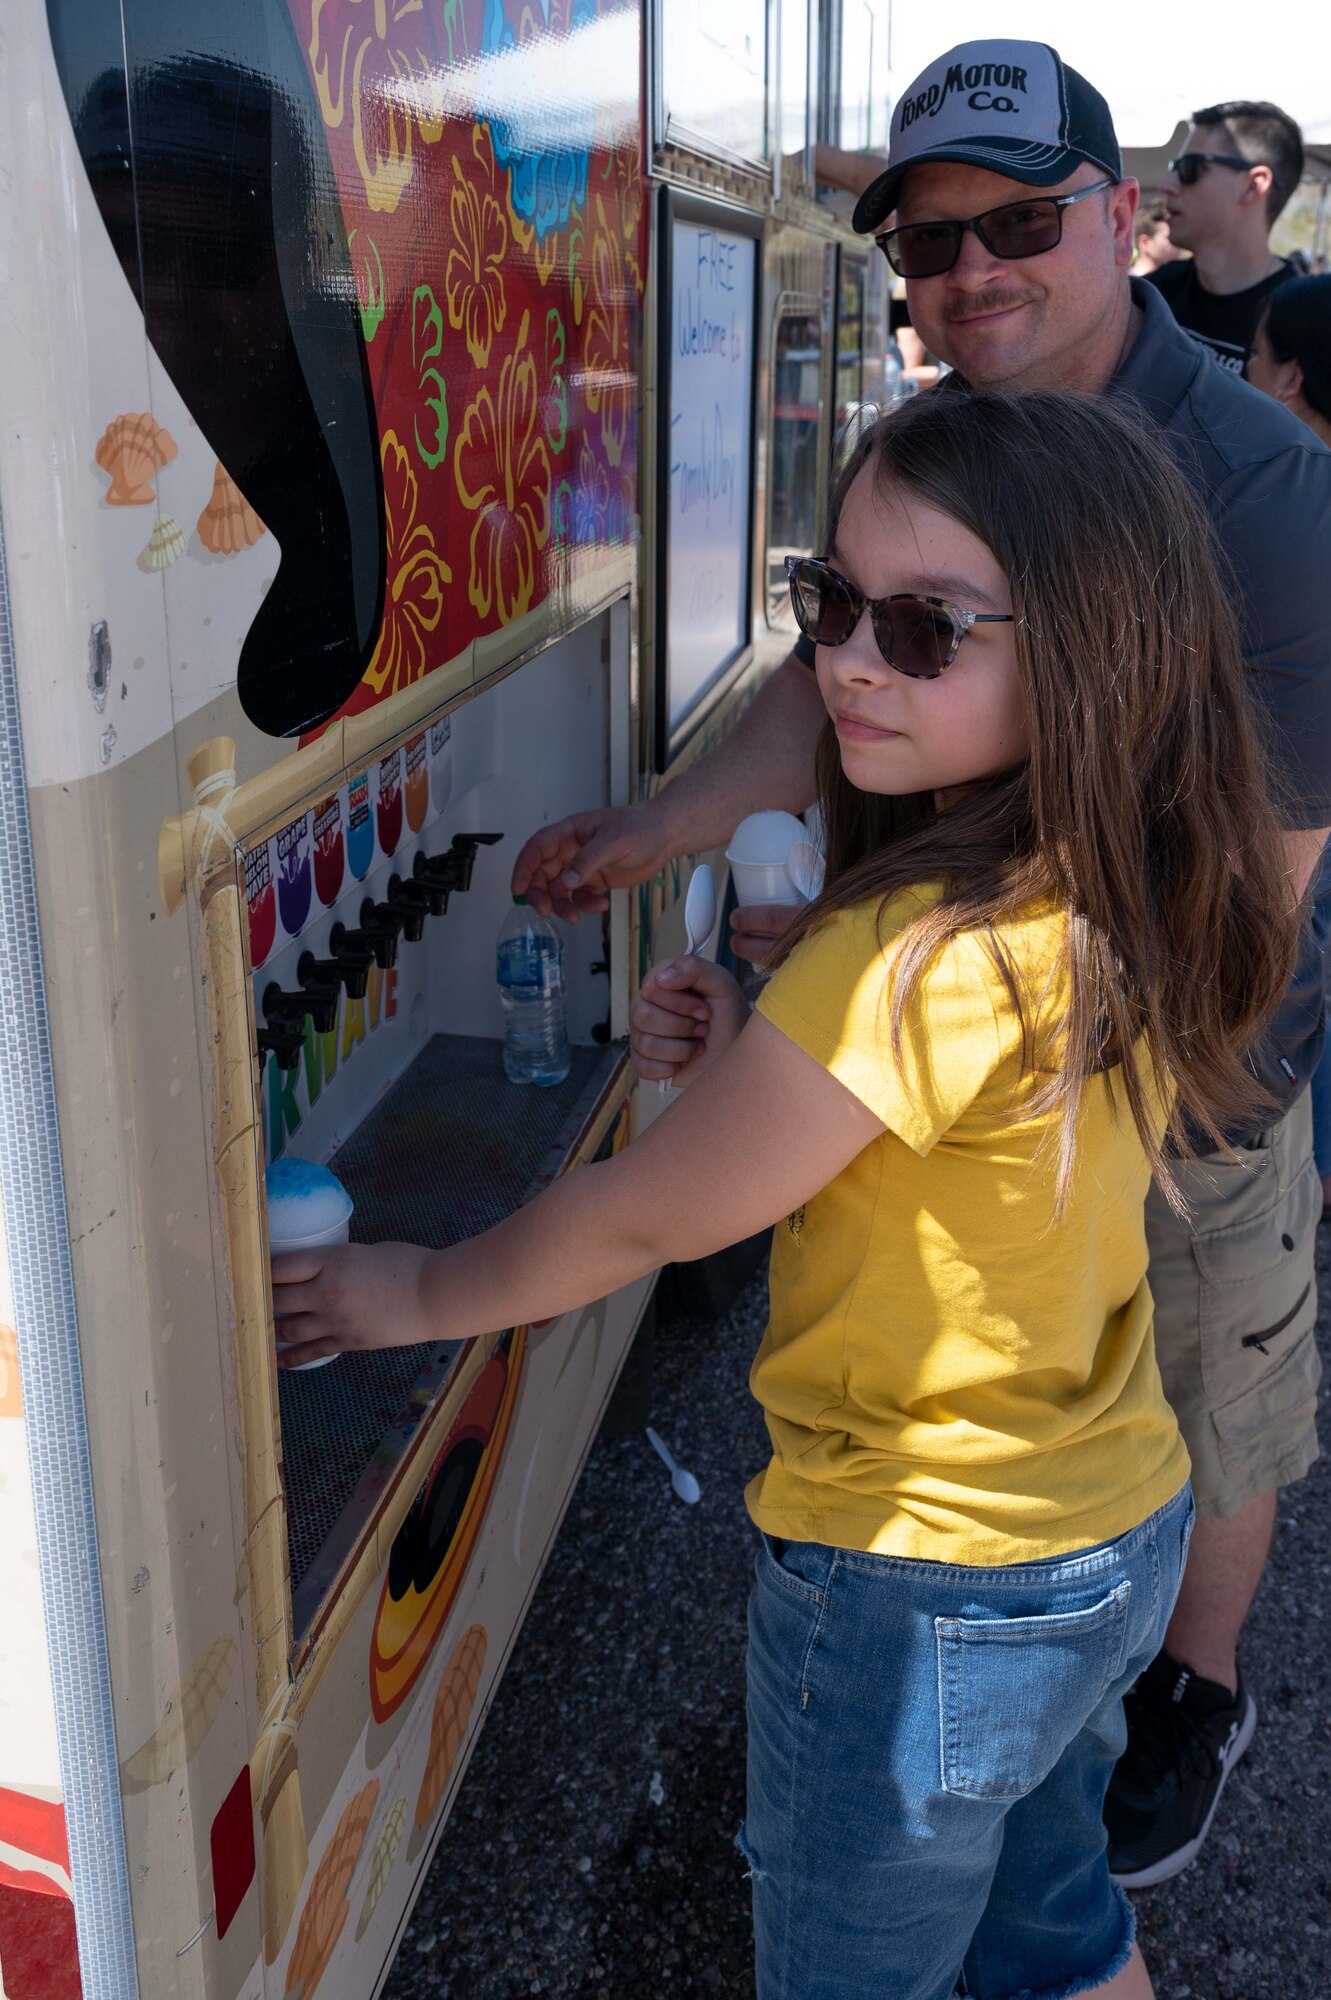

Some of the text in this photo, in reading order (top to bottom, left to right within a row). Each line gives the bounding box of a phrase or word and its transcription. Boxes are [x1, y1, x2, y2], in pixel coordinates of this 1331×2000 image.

[900, 63, 1027, 132] FORD MOTOR
[697, 231, 737, 292] FREE
[279, 817, 307, 860] GRAPE
